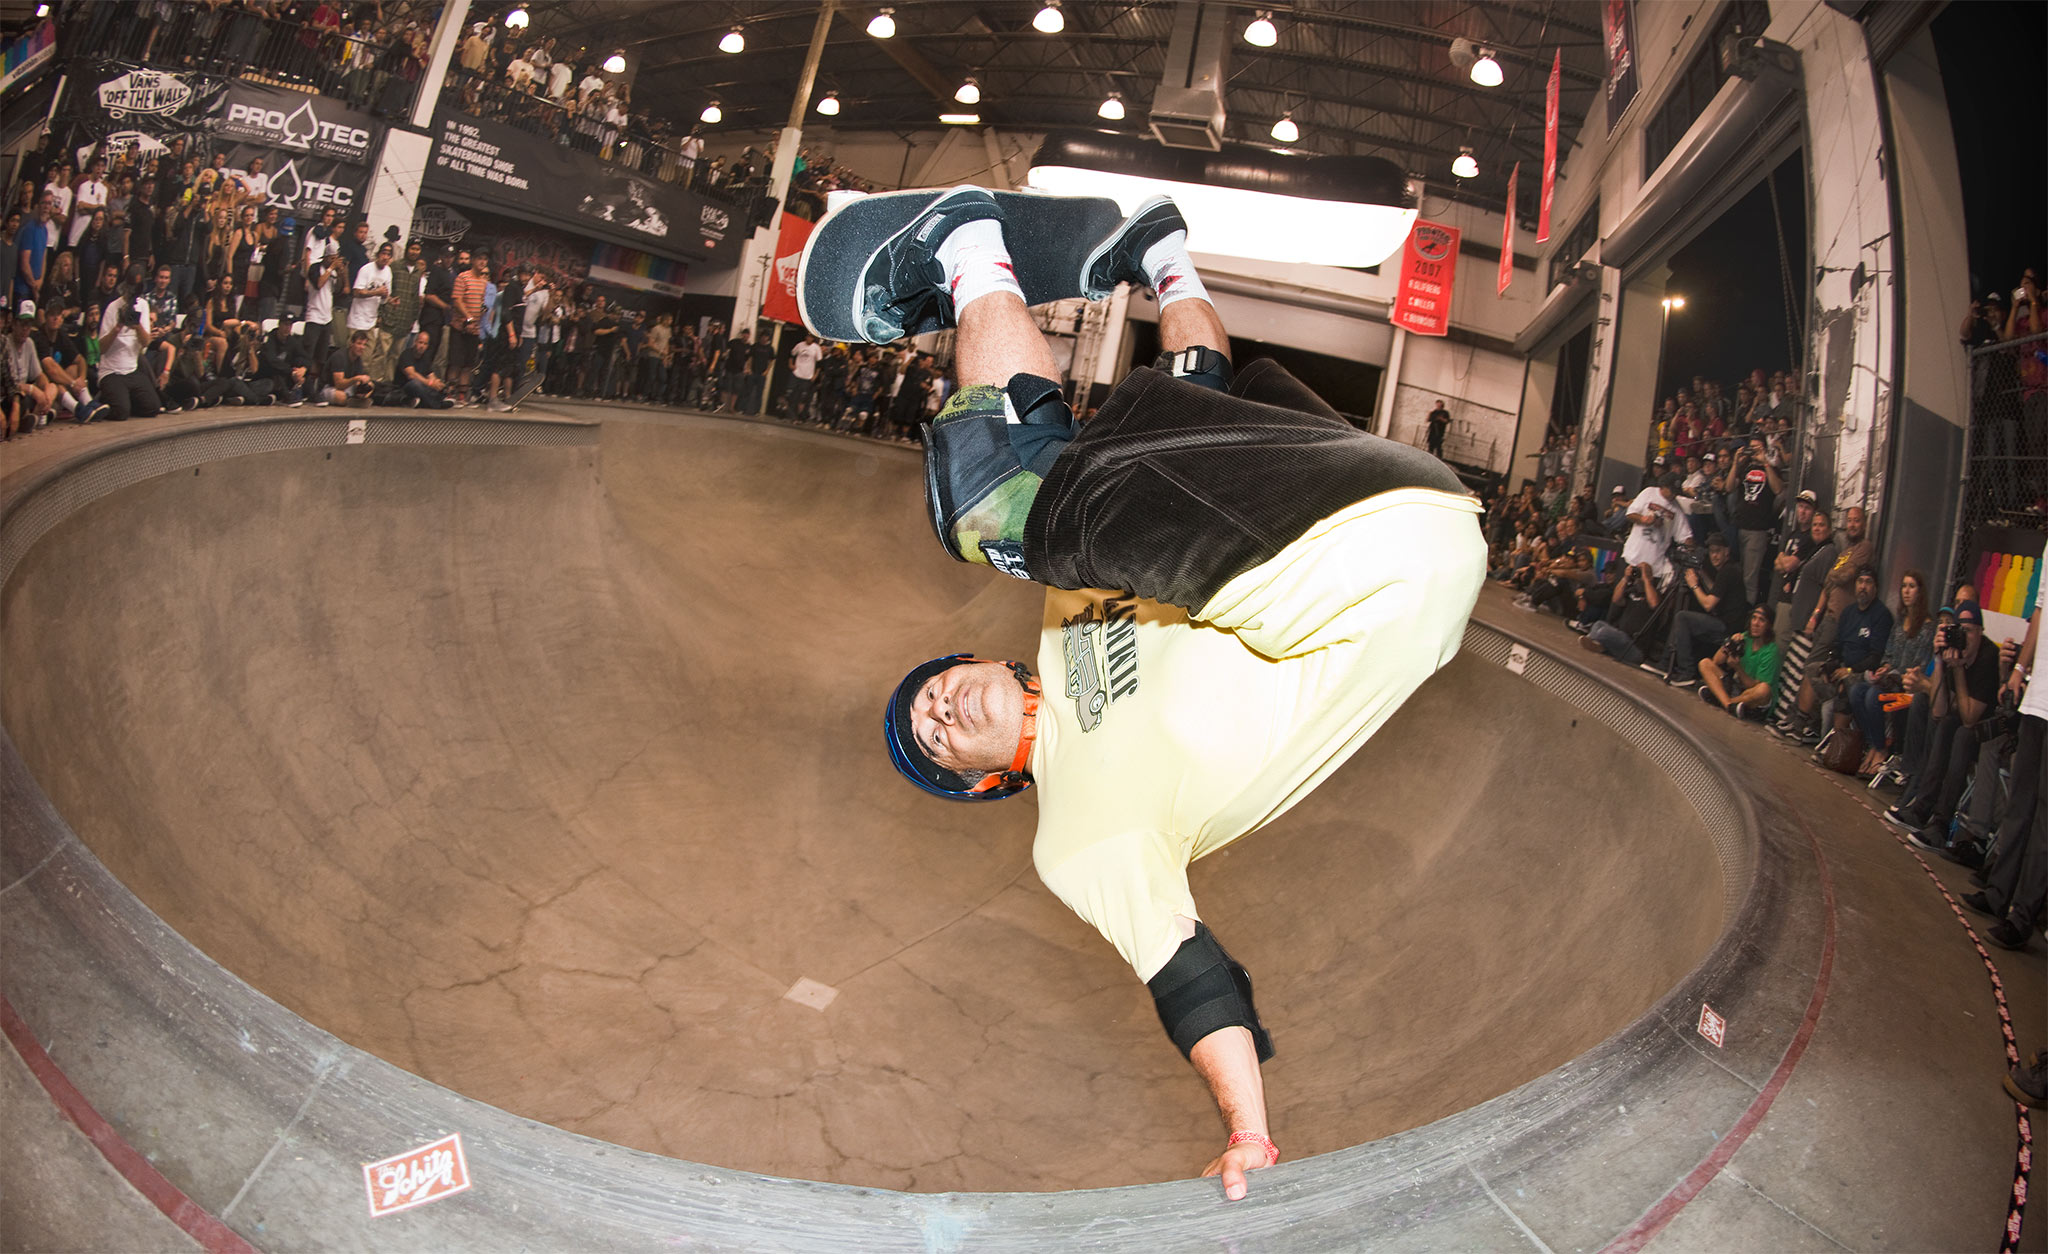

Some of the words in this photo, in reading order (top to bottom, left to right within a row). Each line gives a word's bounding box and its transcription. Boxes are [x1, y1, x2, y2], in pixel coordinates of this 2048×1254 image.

[129, 73, 160, 89] VANS
[104, 89, 127, 105] "OFF
[129, 89, 152, 109] THE
[228, 103, 286, 130] PRO
[319, 121, 370, 148] TEC
[444, 132, 461, 144] THE
[461, 136, 501, 156] GREATEST
[440, 144, 493, 167] SKATEBOARD
[493, 159, 515, 174] SHOE
[449, 159, 466, 171] ALL
[466, 163, 487, 178] TIME
[486, 169, 505, 183] WAS
[302, 180, 353, 206] TEC
[421, 206, 446, 219] VANS
[421, 220, 442, 235] THE
[1415, 260, 1442, 278] 2007
